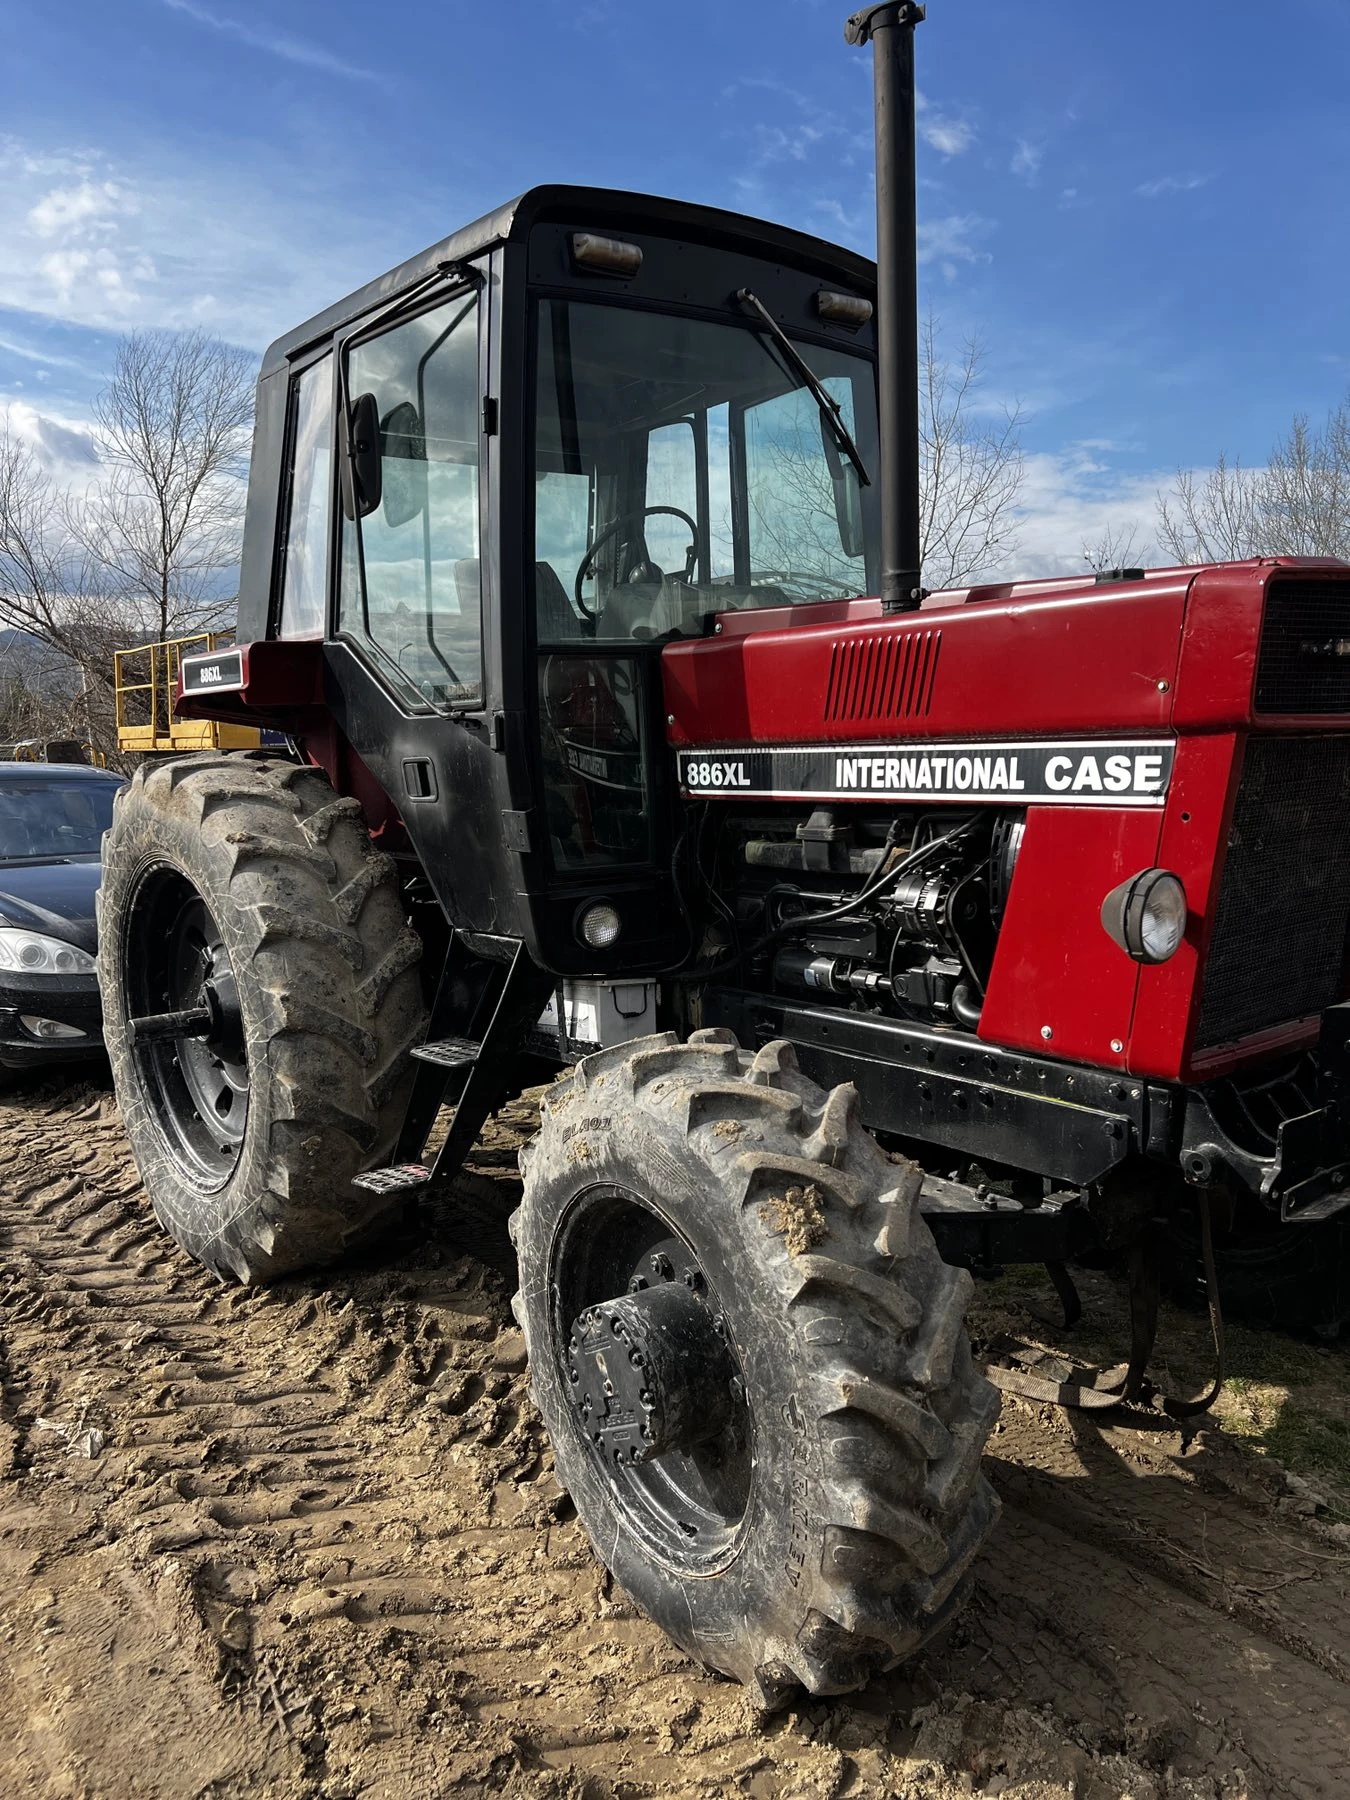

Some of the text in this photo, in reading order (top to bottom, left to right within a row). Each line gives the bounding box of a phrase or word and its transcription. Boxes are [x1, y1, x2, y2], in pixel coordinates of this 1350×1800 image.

[200, 665, 222, 683] 886XL
[686, 754, 1163, 792] 886XL INTERNATIONAL CASE
